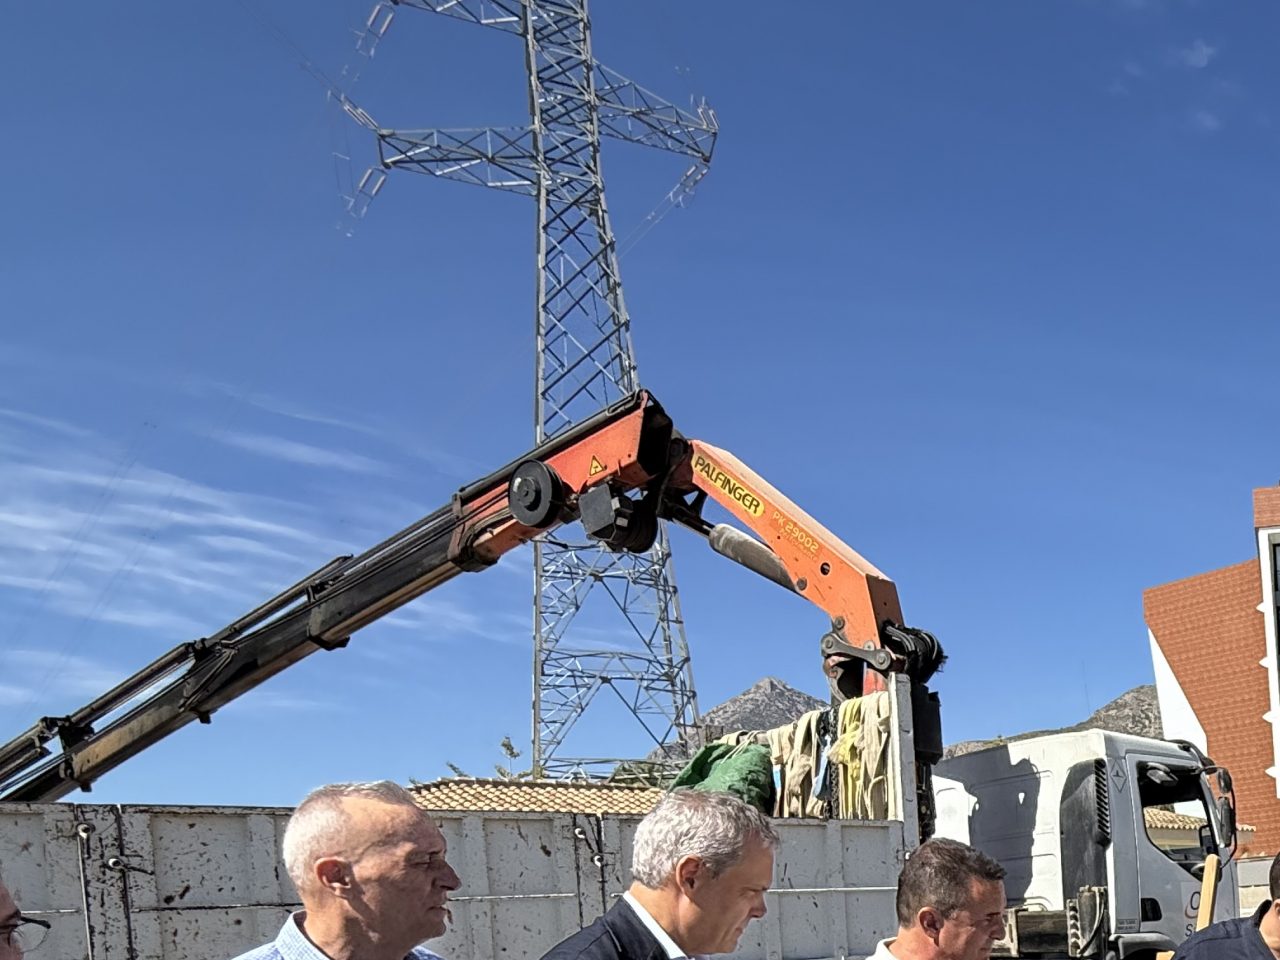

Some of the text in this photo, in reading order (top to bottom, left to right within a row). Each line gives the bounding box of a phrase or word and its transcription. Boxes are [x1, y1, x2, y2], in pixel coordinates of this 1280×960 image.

[695, 456, 760, 514] PALFINGER
[772, 511, 820, 554] PK 29002
